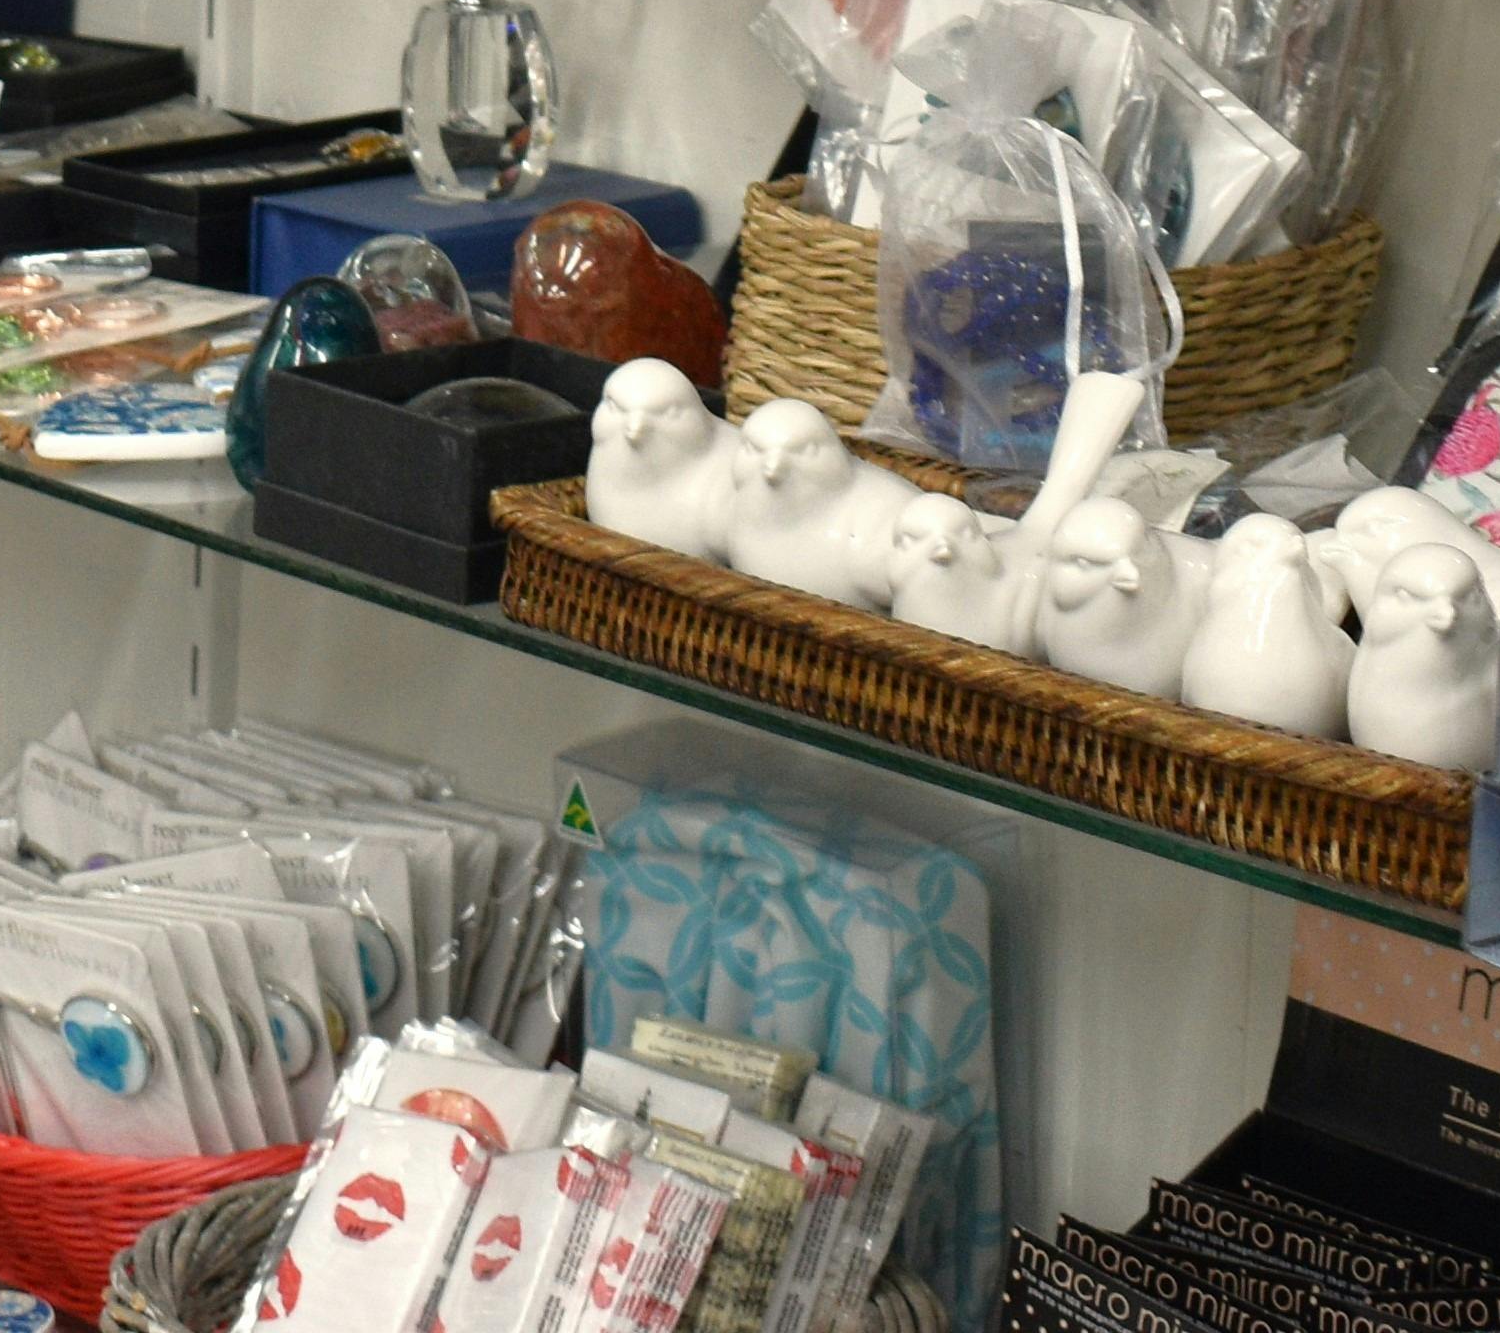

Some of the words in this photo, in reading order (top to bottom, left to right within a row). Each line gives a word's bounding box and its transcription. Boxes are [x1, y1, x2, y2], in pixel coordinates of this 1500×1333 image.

[1440, 1125, 1463, 1145] The
[1450, 1085, 1489, 1118] The
[1065, 1227, 1178, 1300] macro
[1158, 1189, 1275, 1250] macro
[1282, 1230, 1388, 1286] mirror
[1019, 1240, 1130, 1321] macro
